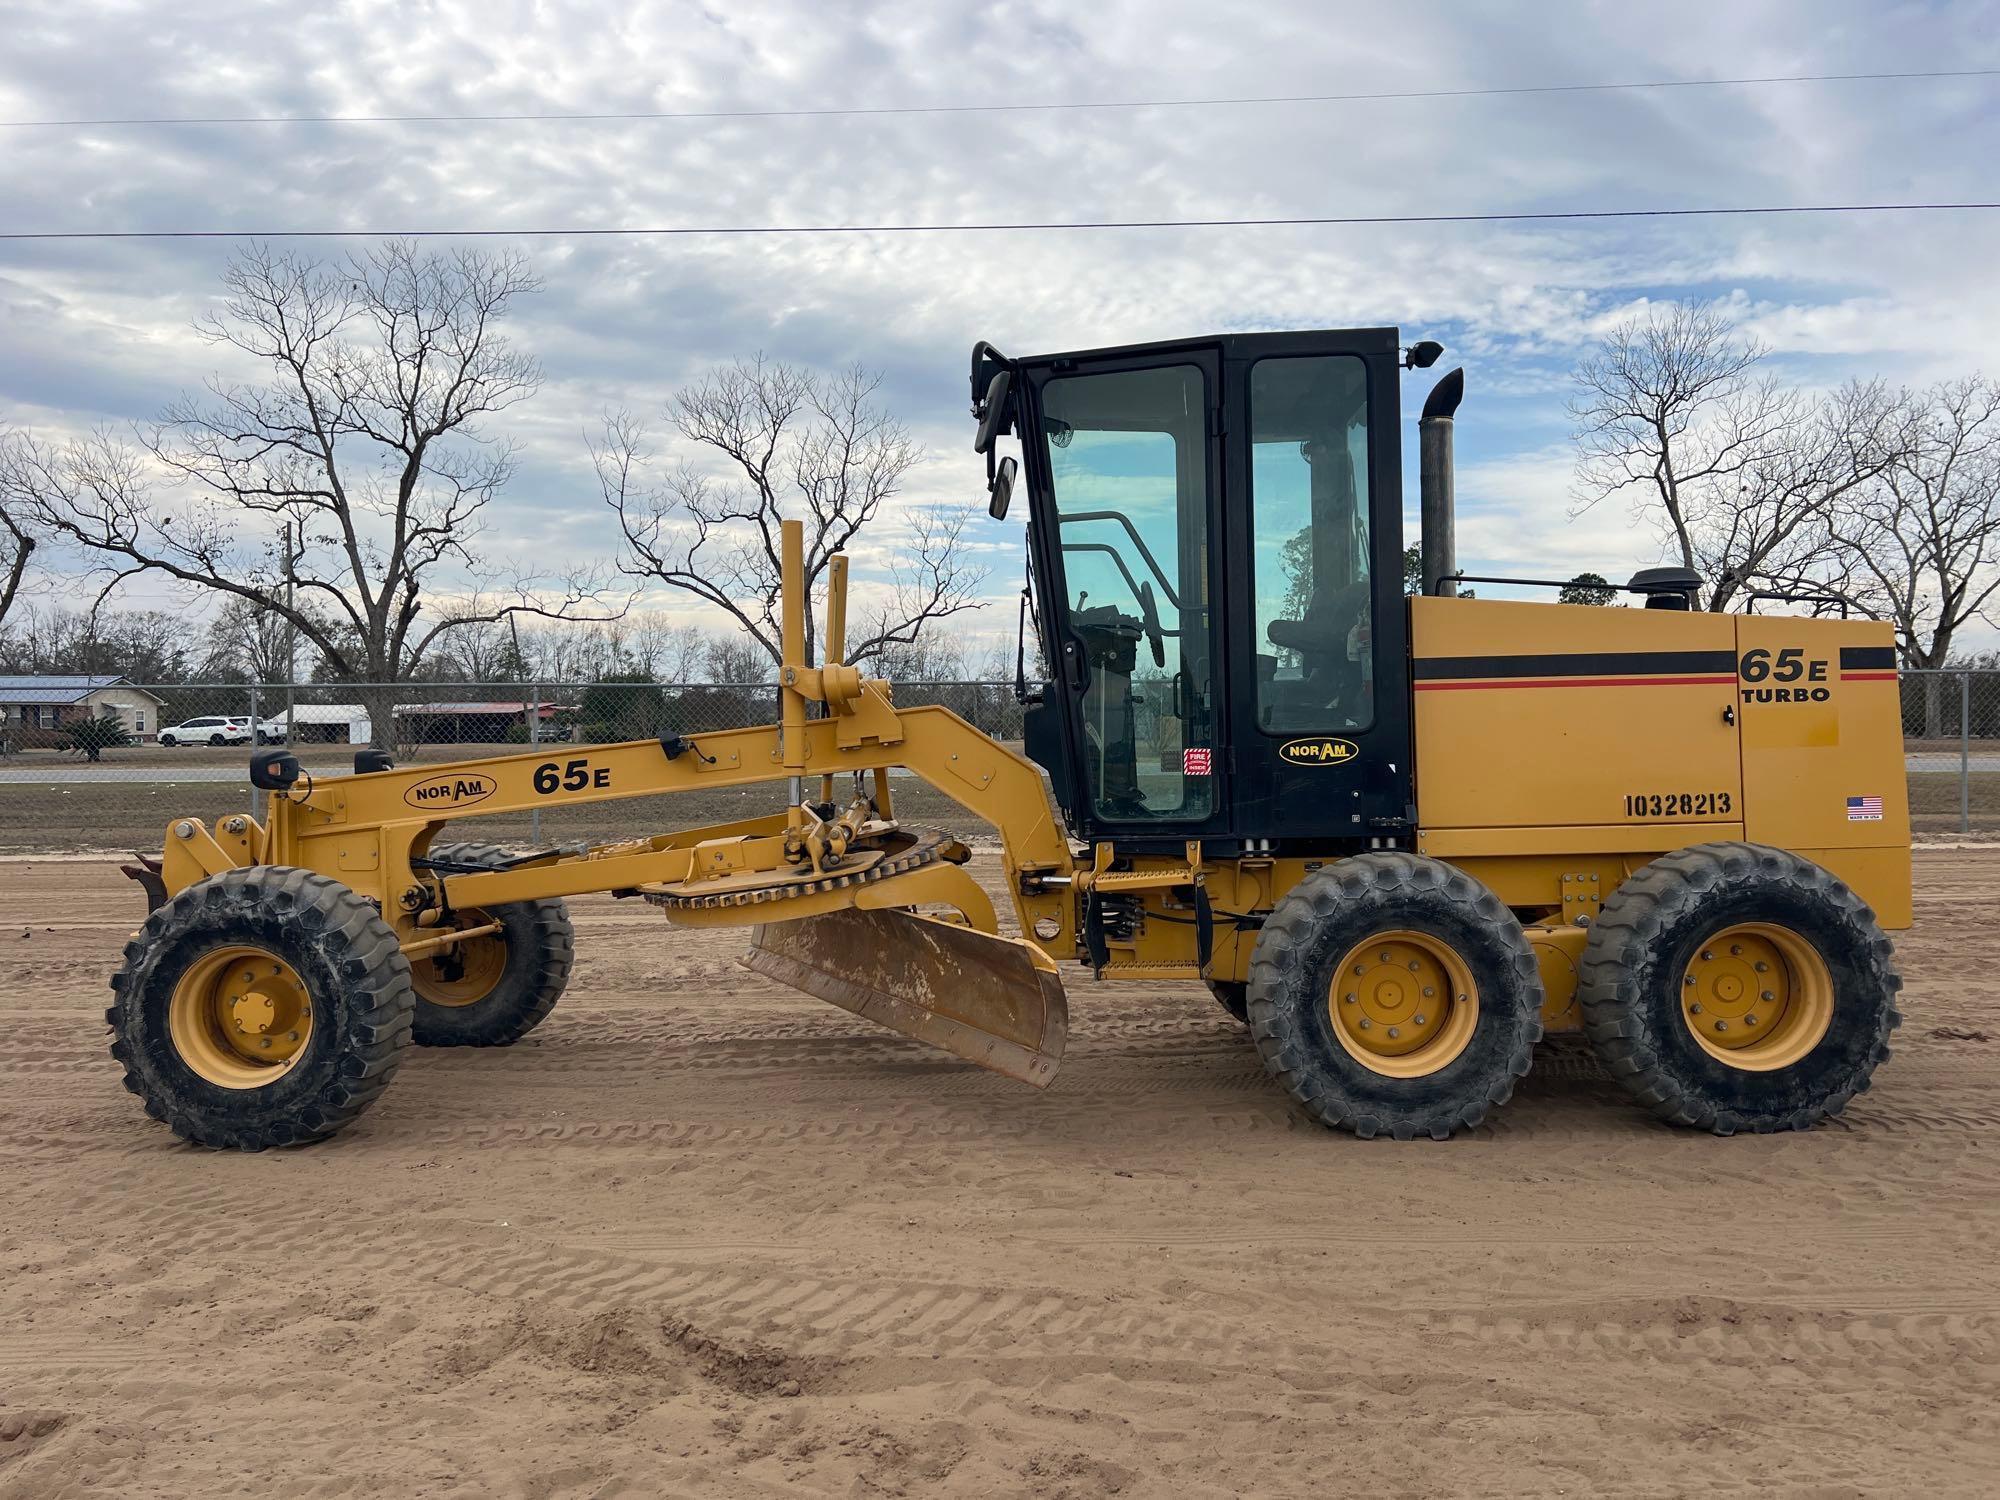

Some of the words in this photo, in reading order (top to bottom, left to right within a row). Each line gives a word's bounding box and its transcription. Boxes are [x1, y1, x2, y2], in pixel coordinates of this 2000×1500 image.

[1740, 648, 1828, 683] 65E
[1740, 687, 1830, 704] TURBO
[533, 759, 611, 795] 65E
[1626, 792, 1731, 817] 10328213
